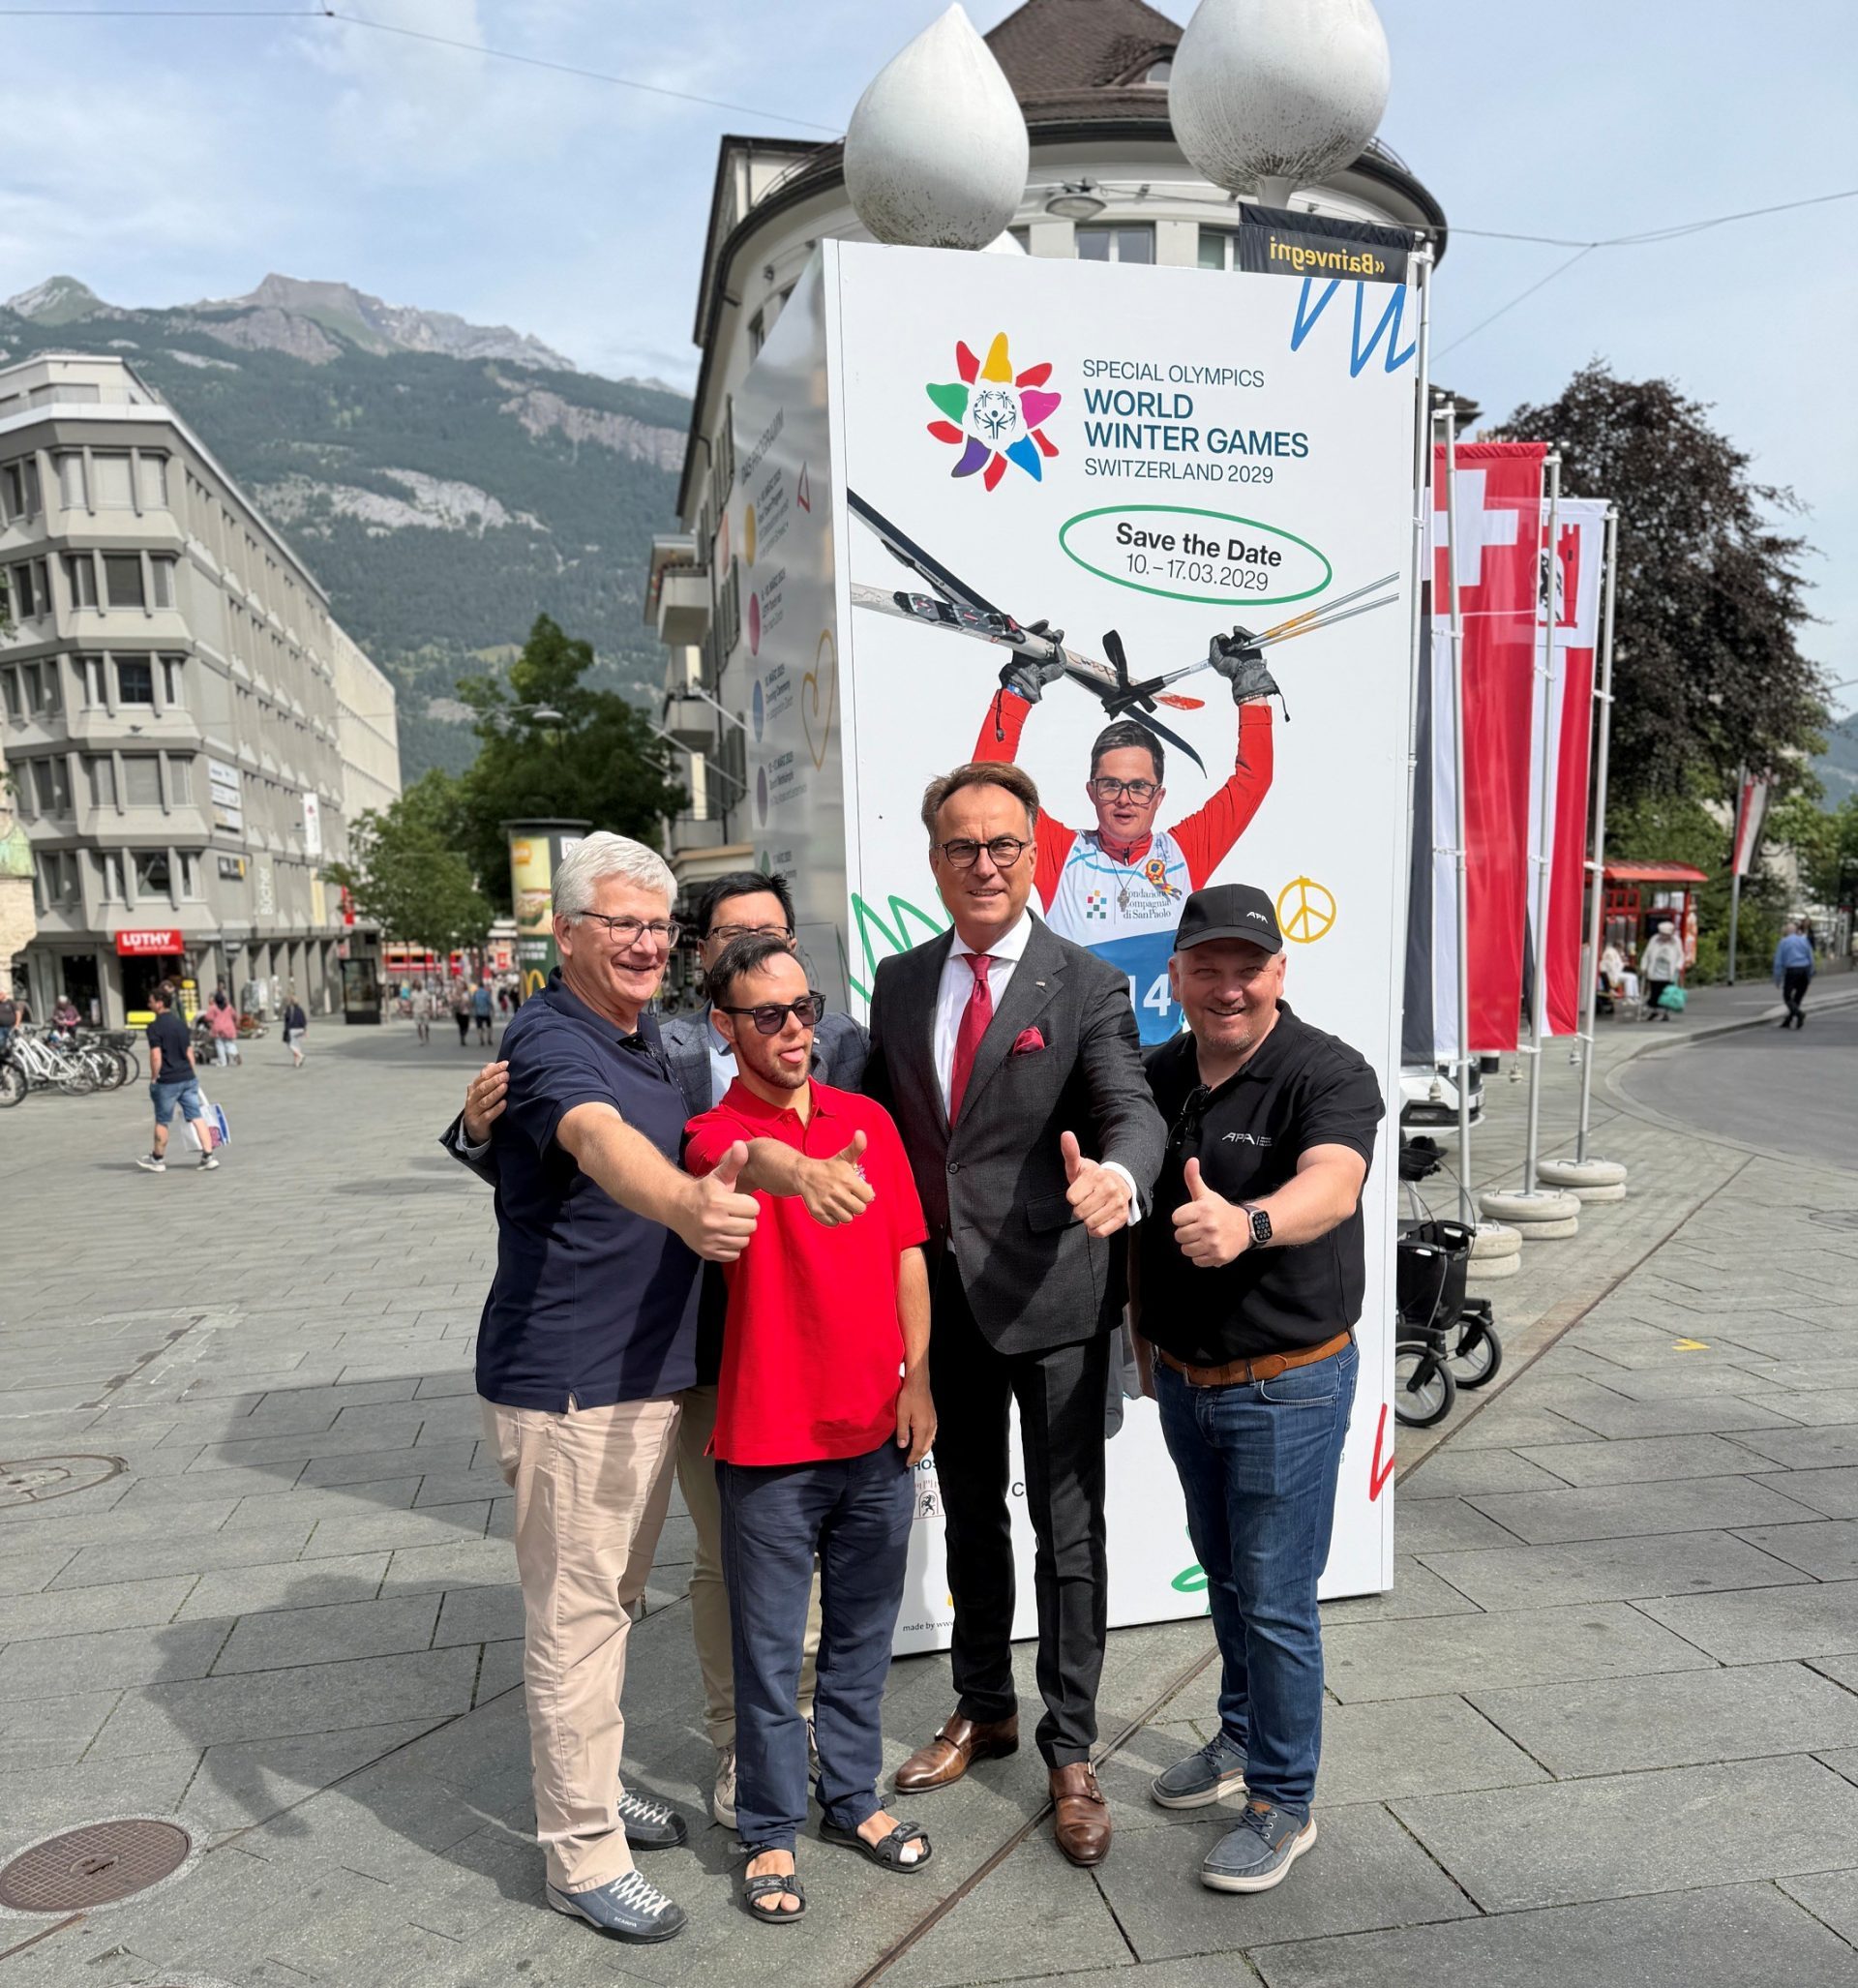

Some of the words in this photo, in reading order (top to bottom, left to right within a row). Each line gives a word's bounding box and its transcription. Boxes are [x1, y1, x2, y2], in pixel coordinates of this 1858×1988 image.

[1083, 359, 1164, 381] SPECIAL
[1168, 365, 1265, 387] OLYMPICS
[1084, 388, 1194, 419] WORLD
[1084, 421, 1200, 452] WINTER
[1207, 428, 1309, 458] GAMES
[1085, 458, 1223, 481] SWITZERLAND
[1228, 465, 1274, 484] 2029
[1116, 522, 1176, 551] Save
[1183, 533, 1220, 557] the
[1227, 539, 1282, 567] Date
[1124, 909, 1131, 919] di
[1132, 909, 1149, 919] San
[1149, 908, 1171, 919] Paolo
[1128, 900, 1171, 910] ompagnia
[1222, 1132, 1255, 1145] APA
[902, 1622, 924, 1632] made
[925, 1622, 936, 1632] by
